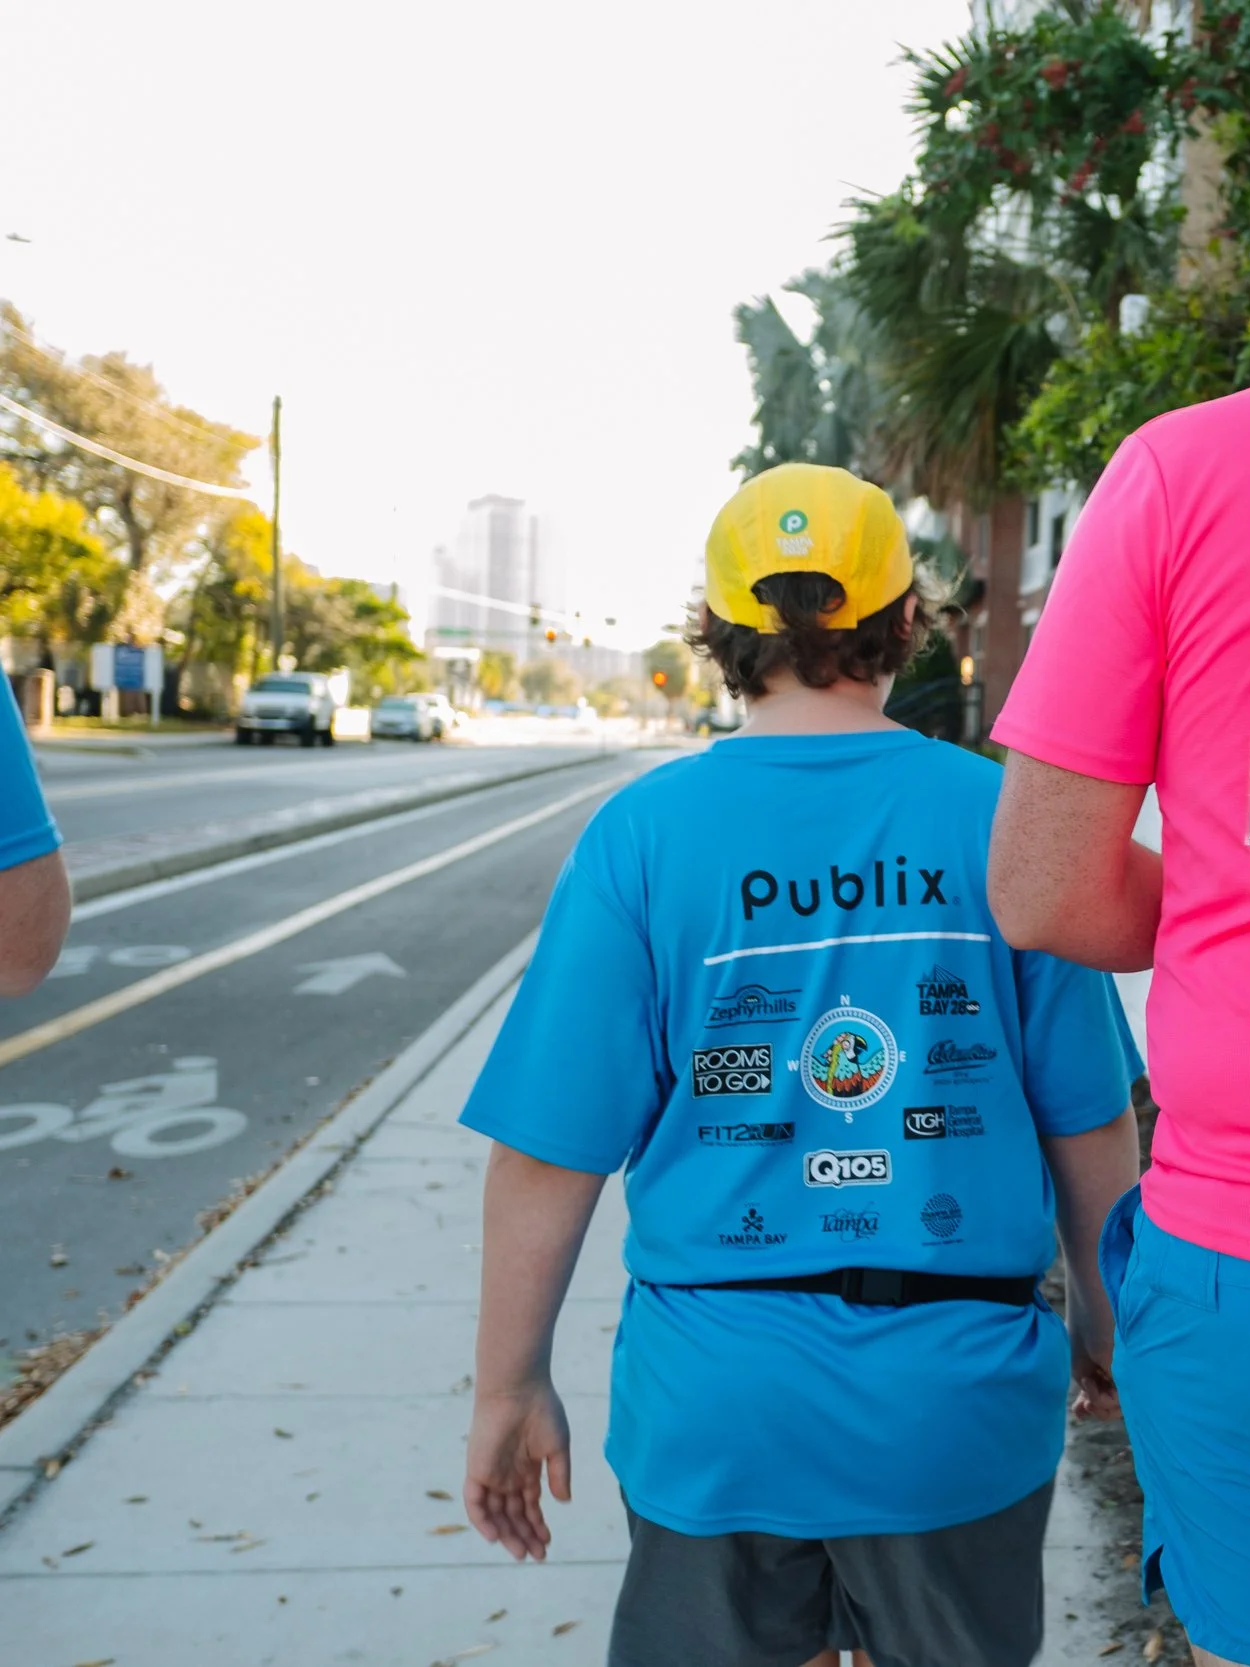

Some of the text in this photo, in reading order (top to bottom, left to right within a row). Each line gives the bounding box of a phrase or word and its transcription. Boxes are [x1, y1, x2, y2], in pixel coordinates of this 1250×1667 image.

[916, 983, 969, 999] TAMPA
[840, 994, 851, 1006] N
[919, 1000, 949, 1016] BAY
[709, 998, 797, 1021] Zephyrhills
[694, 1048, 770, 1072] ROOMS
[899, 1050, 907, 1062] E
[787, 1060, 800, 1072] W
[695, 1072, 760, 1093] TO GO
[844, 1112, 854, 1124] S
[911, 1112, 945, 1129] TGH
[698, 1122, 795, 1141] FIT2RUN
[810, 1152, 886, 1184] Q105
[718, 1233, 788, 1245] TAMPA BAY
